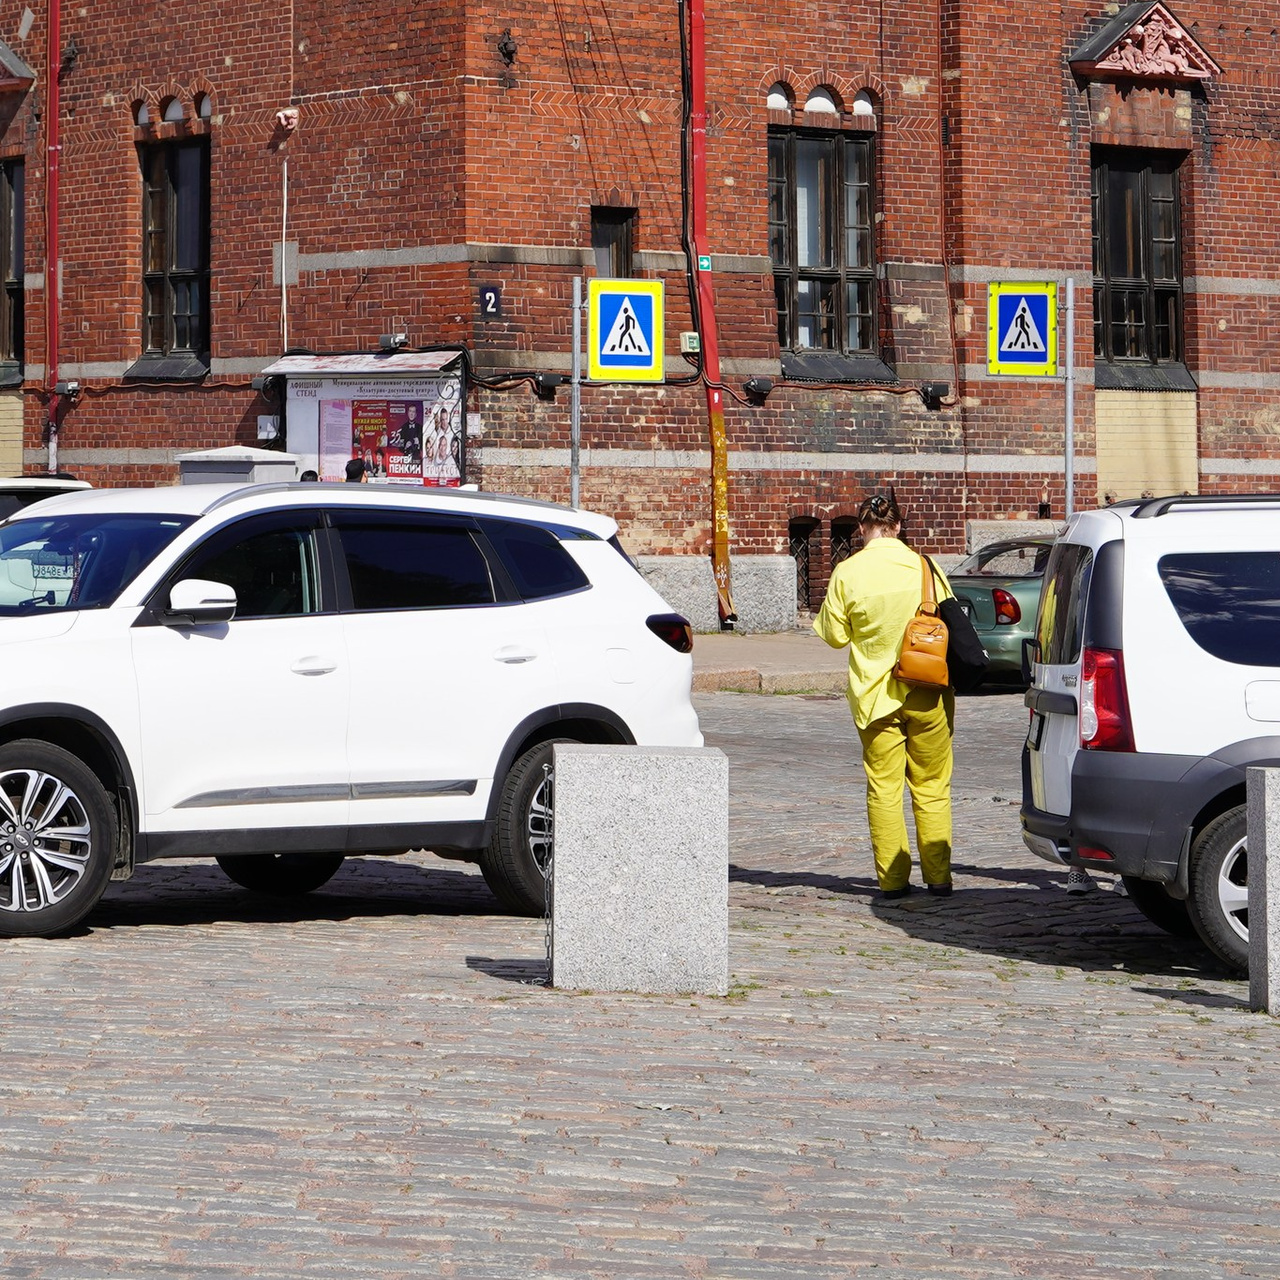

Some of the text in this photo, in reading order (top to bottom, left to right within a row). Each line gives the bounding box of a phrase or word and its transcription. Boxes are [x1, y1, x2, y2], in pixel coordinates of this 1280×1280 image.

[485, 292, 497, 313] 2
[290, 381, 323, 389] АФИШНЫЙ
[332, 379, 372, 387] Муниципальное
[389, 454, 412, 463] СЕРГЕЙ
[389, 463, 421, 474] ПЕНКИН
